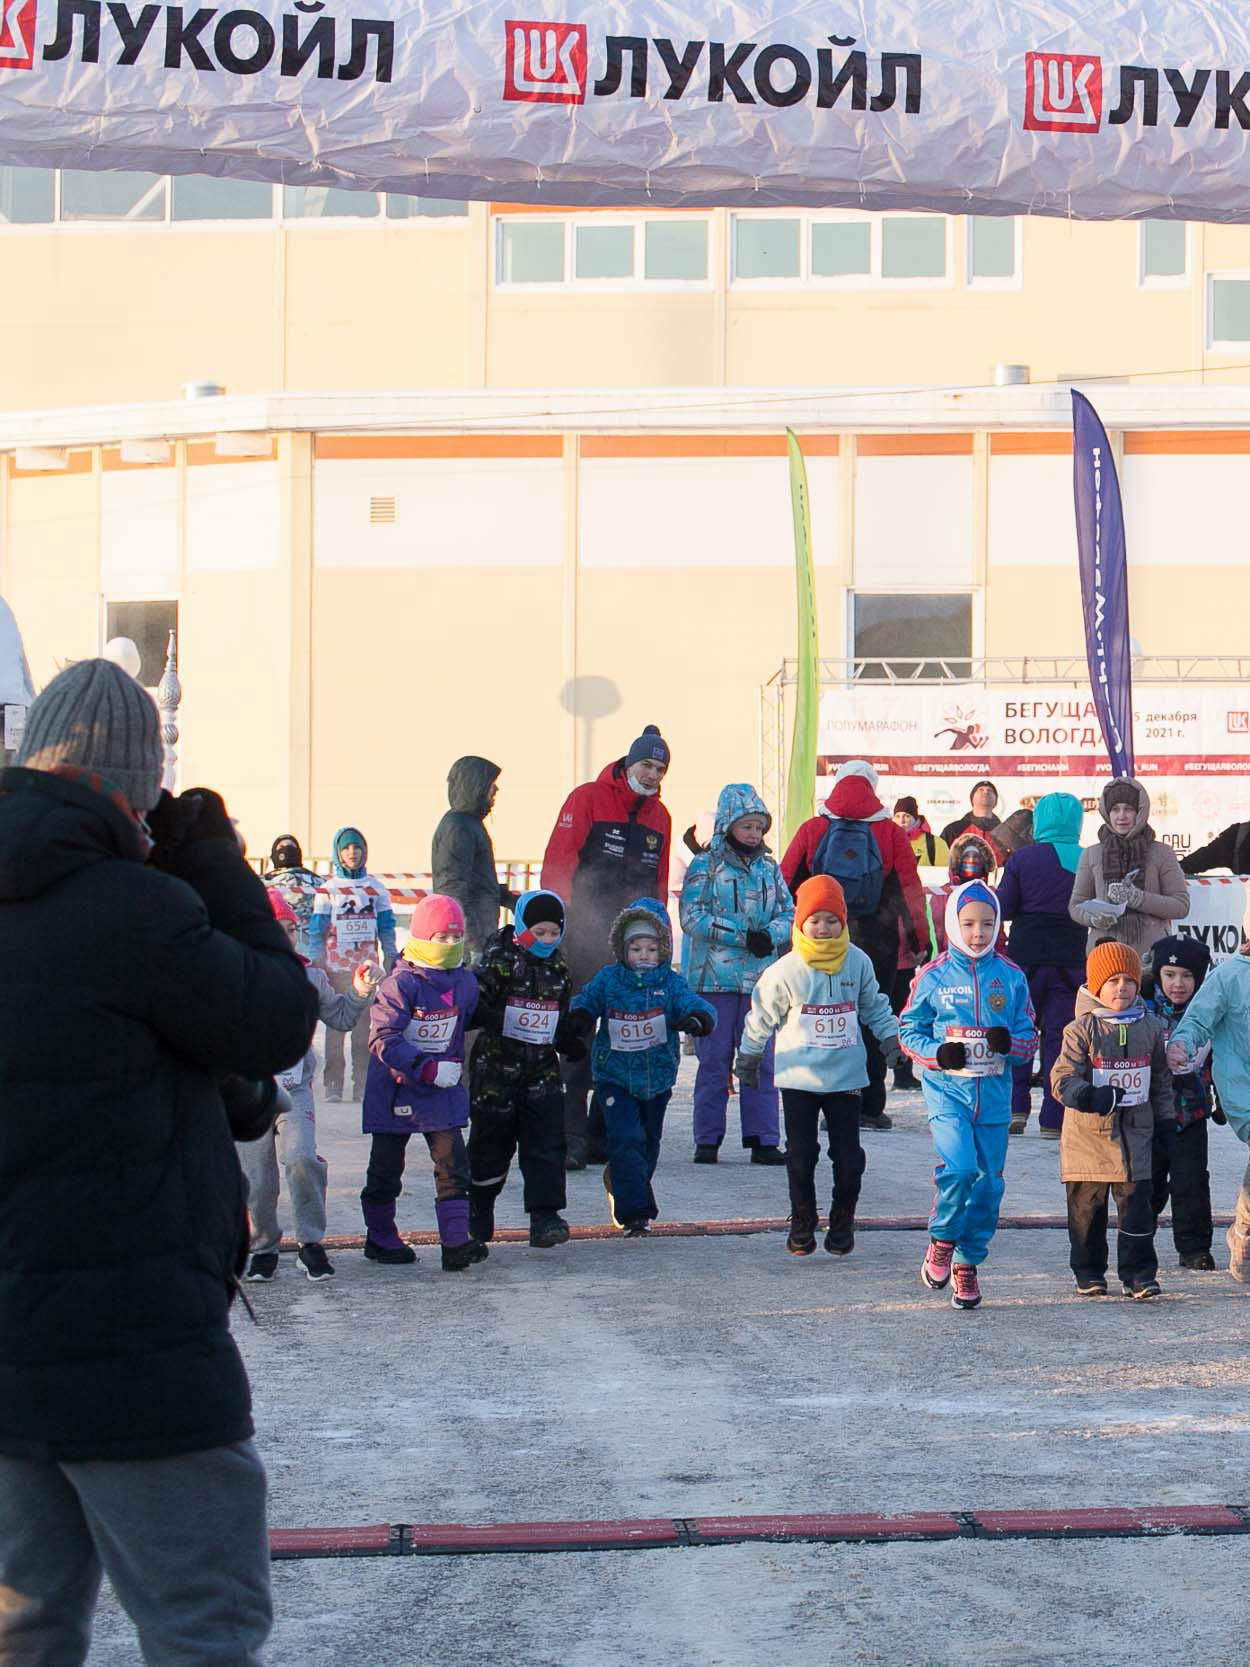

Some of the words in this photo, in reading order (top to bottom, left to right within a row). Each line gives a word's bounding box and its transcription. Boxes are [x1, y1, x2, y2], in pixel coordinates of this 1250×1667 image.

[42, 0, 395, 83] ЛУКОЙЛ
[594, 34, 921, 114] ЛУКОЙЛ
[1005, 702, 1097, 722] БЕГУЩА
[1146, 711, 1197, 723] декабря
[827, 719, 918, 732] ПОЛУМАРАФОН
[1145, 728, 1173, 738] 2021
[346, 920, 368, 931] 654
[526, 1002, 541, 1010] 600
[518, 1012, 549, 1029] 624
[815, 1016, 847, 1033] 619
[417, 1022, 449, 1038] 627
[620, 1022, 653, 1038] 616
[965, 1029, 982, 1038] 600
[1114, 1061, 1130, 1069] 600
[1108, 1071, 1142, 1089] 606
